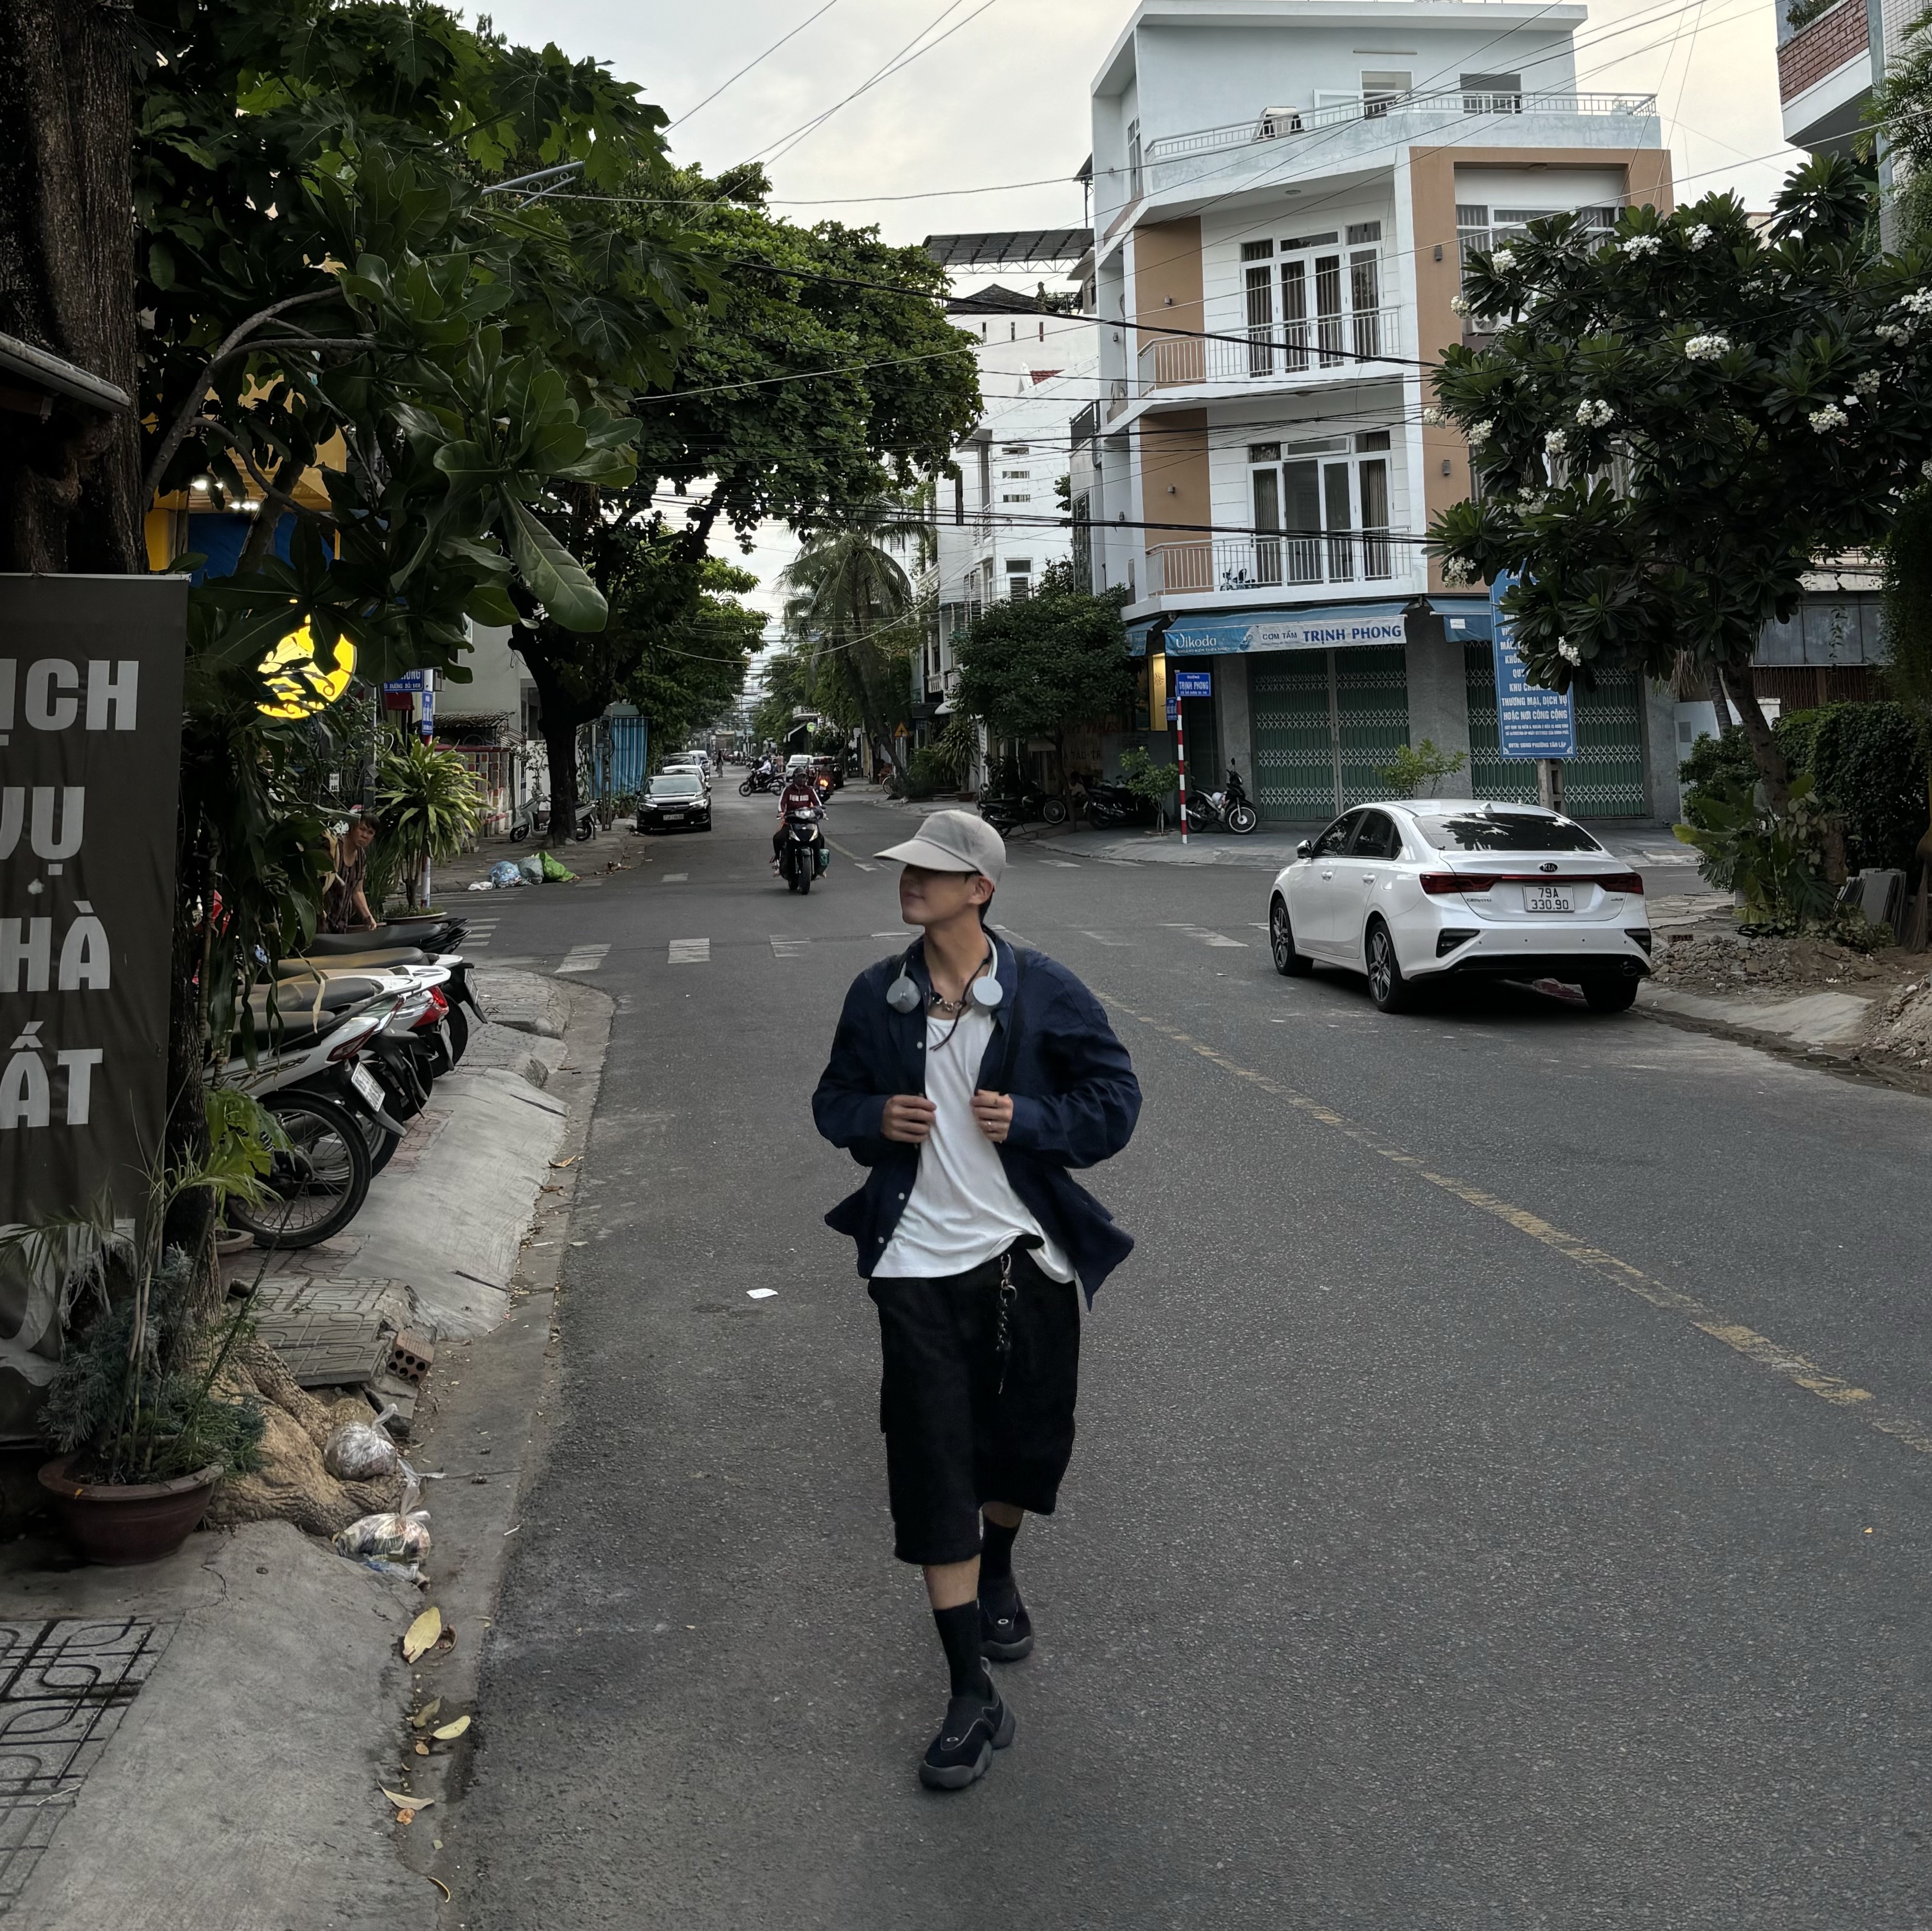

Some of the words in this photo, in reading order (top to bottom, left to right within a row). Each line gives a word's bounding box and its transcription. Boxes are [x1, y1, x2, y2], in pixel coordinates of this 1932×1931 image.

[1303, 628, 1345, 644] TRỊNH
[1352, 625, 1401, 640] PHONG
[1505, 653, 1523, 664] KHÔN
[1194, 681, 1209, 690] PHONG
[1509, 683, 1522, 691] KHU
[1501, 697, 1526, 706] THƯƠNG
[1543, 696, 1558, 707] DỊCH
[1559, 695, 1568, 706] VỤ
[1503, 710, 1519, 722] HOẶC
[1520, 711, 1531, 720] NƠI
[1533, 709, 1550, 720] CÔNG
[1551, 708, 1568, 721] CỘNG
[1538, 888, 1559, 898] 79A
[1531, 900, 1569, 910] 330.90
